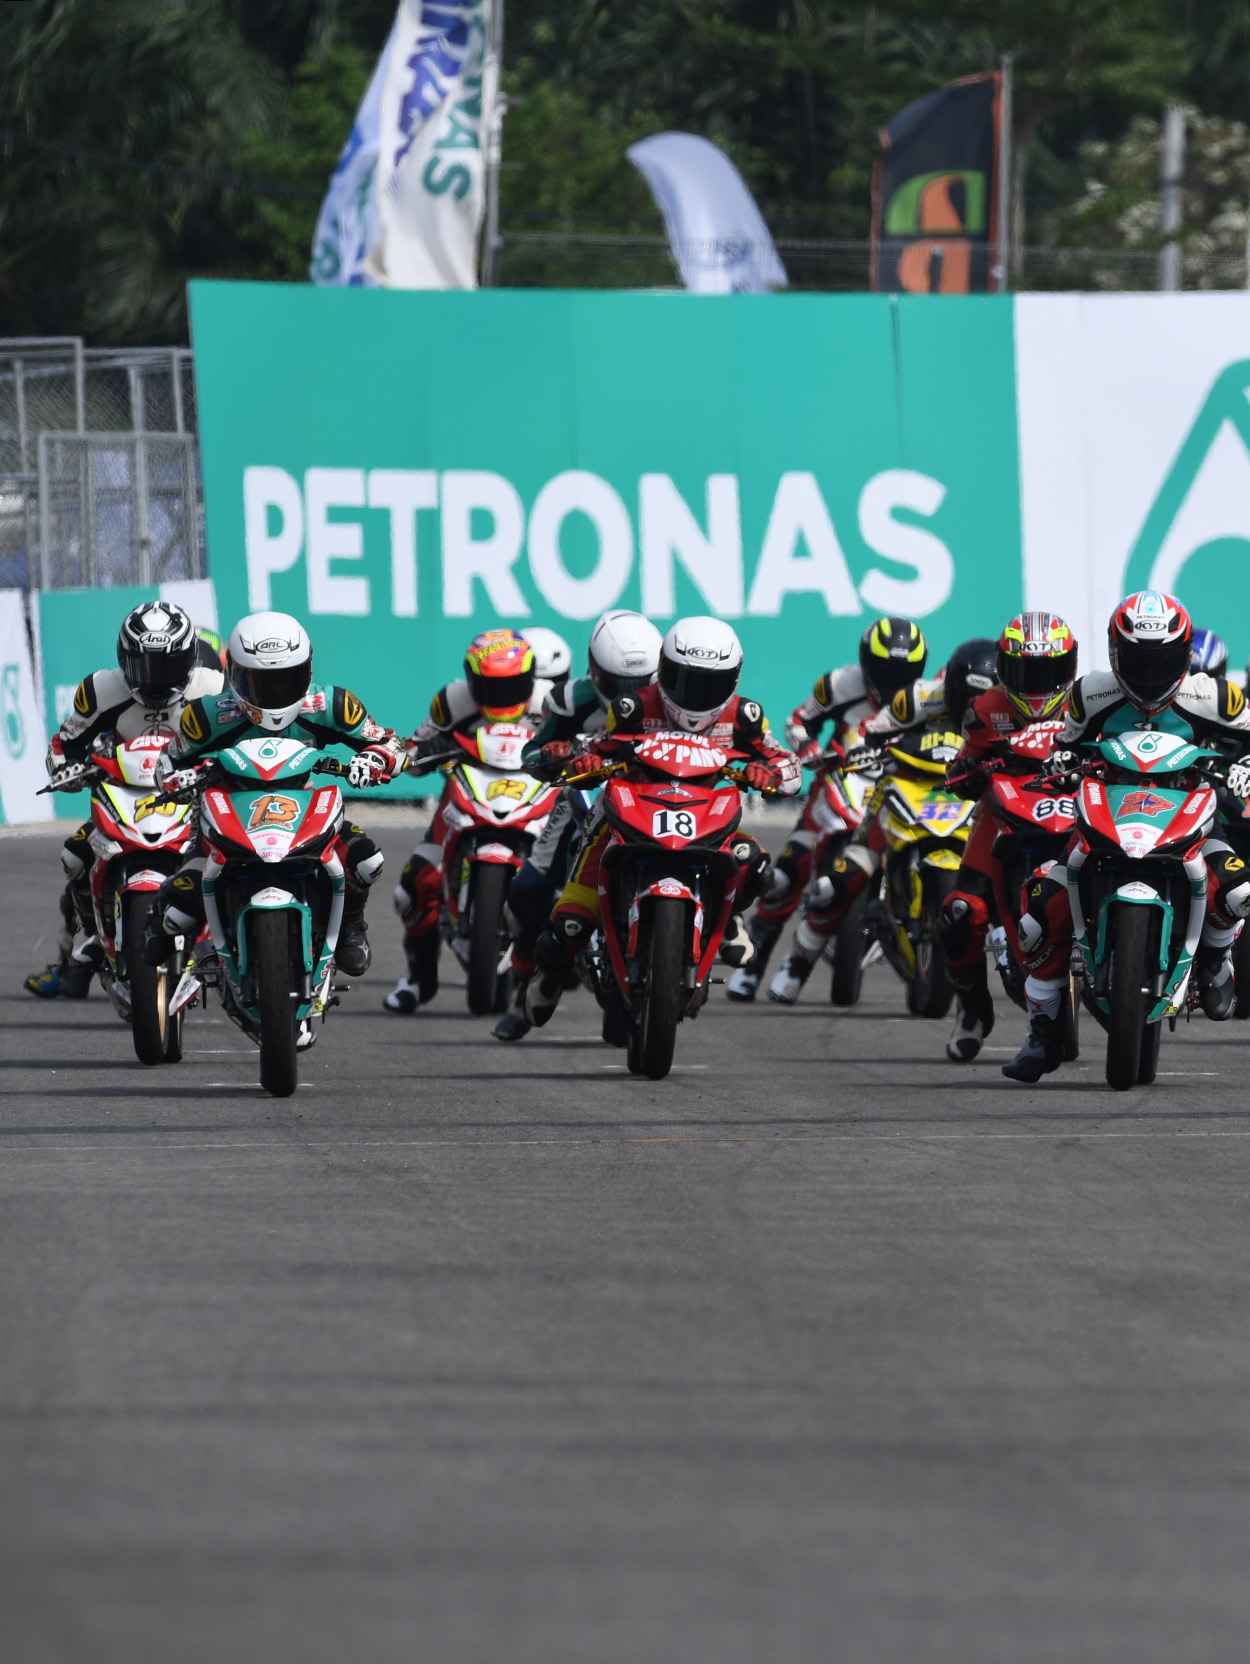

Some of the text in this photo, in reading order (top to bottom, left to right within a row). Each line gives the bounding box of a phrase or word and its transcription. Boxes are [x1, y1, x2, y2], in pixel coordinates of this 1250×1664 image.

[242, 464, 955, 623] PETRONAS
[142, 634, 168, 643] Arai
[1086, 687, 1122, 702] PETRONAS
[655, 731, 710, 747] MOTUL
[486, 778, 528, 801] 62
[248, 795, 300, 828] 13
[656, 810, 694, 838] 18
